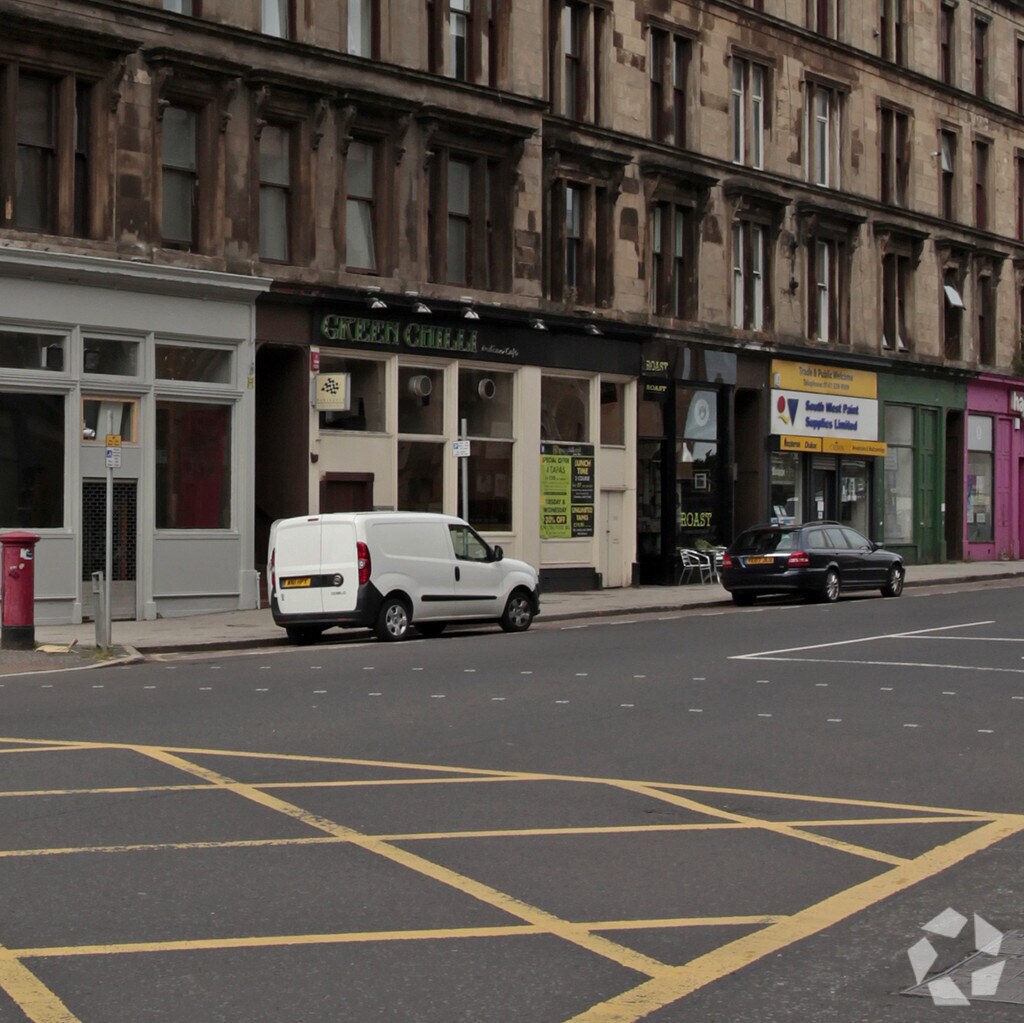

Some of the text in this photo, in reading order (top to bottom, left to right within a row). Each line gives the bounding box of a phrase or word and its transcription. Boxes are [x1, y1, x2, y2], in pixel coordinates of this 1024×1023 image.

[321, 314, 478, 352] GREEN CHILLI
[646, 360, 668, 371] ROAST
[818, 368, 832, 379] Public
[646, 384, 667, 392] ROAST
[805, 400, 859, 416] South West Paint
[1011, 391, 1024, 418] ha
[805, 417, 857, 431] Supplies Limited
[575, 459, 591, 467] LUNCH
[556, 516, 566, 524] OFF
[681, 512, 712, 527] ROAST
